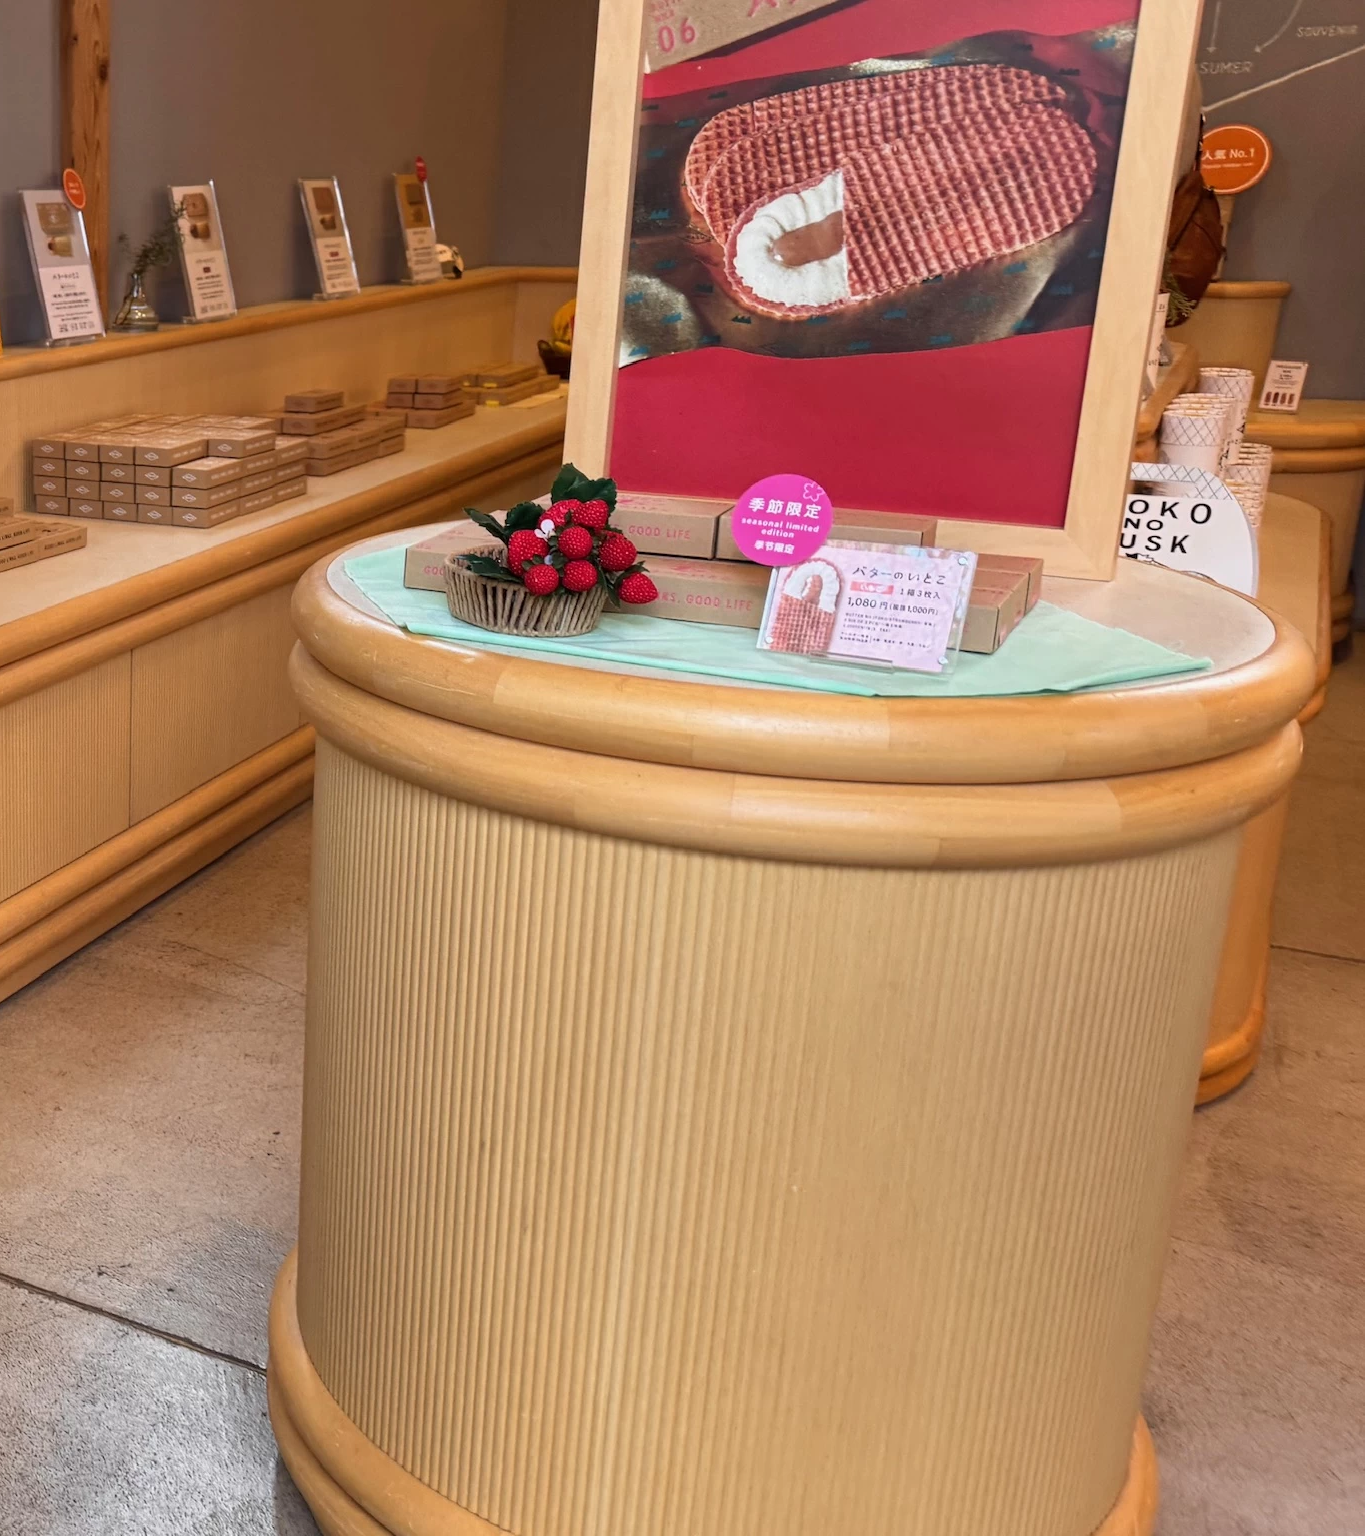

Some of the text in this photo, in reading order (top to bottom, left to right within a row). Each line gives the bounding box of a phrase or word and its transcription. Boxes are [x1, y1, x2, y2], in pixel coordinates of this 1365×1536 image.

[658, 17, 696, 52] 06
[1199, 61, 1253, 74] SUMER
[748, 497, 822, 519] 季節限定
[1128, 499, 1212, 525] OKO
[741, 517, 820, 533] seasonal limited
[1123, 517, 1164, 531] NO
[628, 525, 691, 540] GOOD LIFE
[761, 528, 795, 538] edition
[1119, 533, 1189, 554] USK
[852, 566, 947, 585] バターのいとこ
[899, 588, 941, 600] 1箱3枚入
[686, 594, 720, 607] GOOD
[726, 598, 754, 611] LIFE
